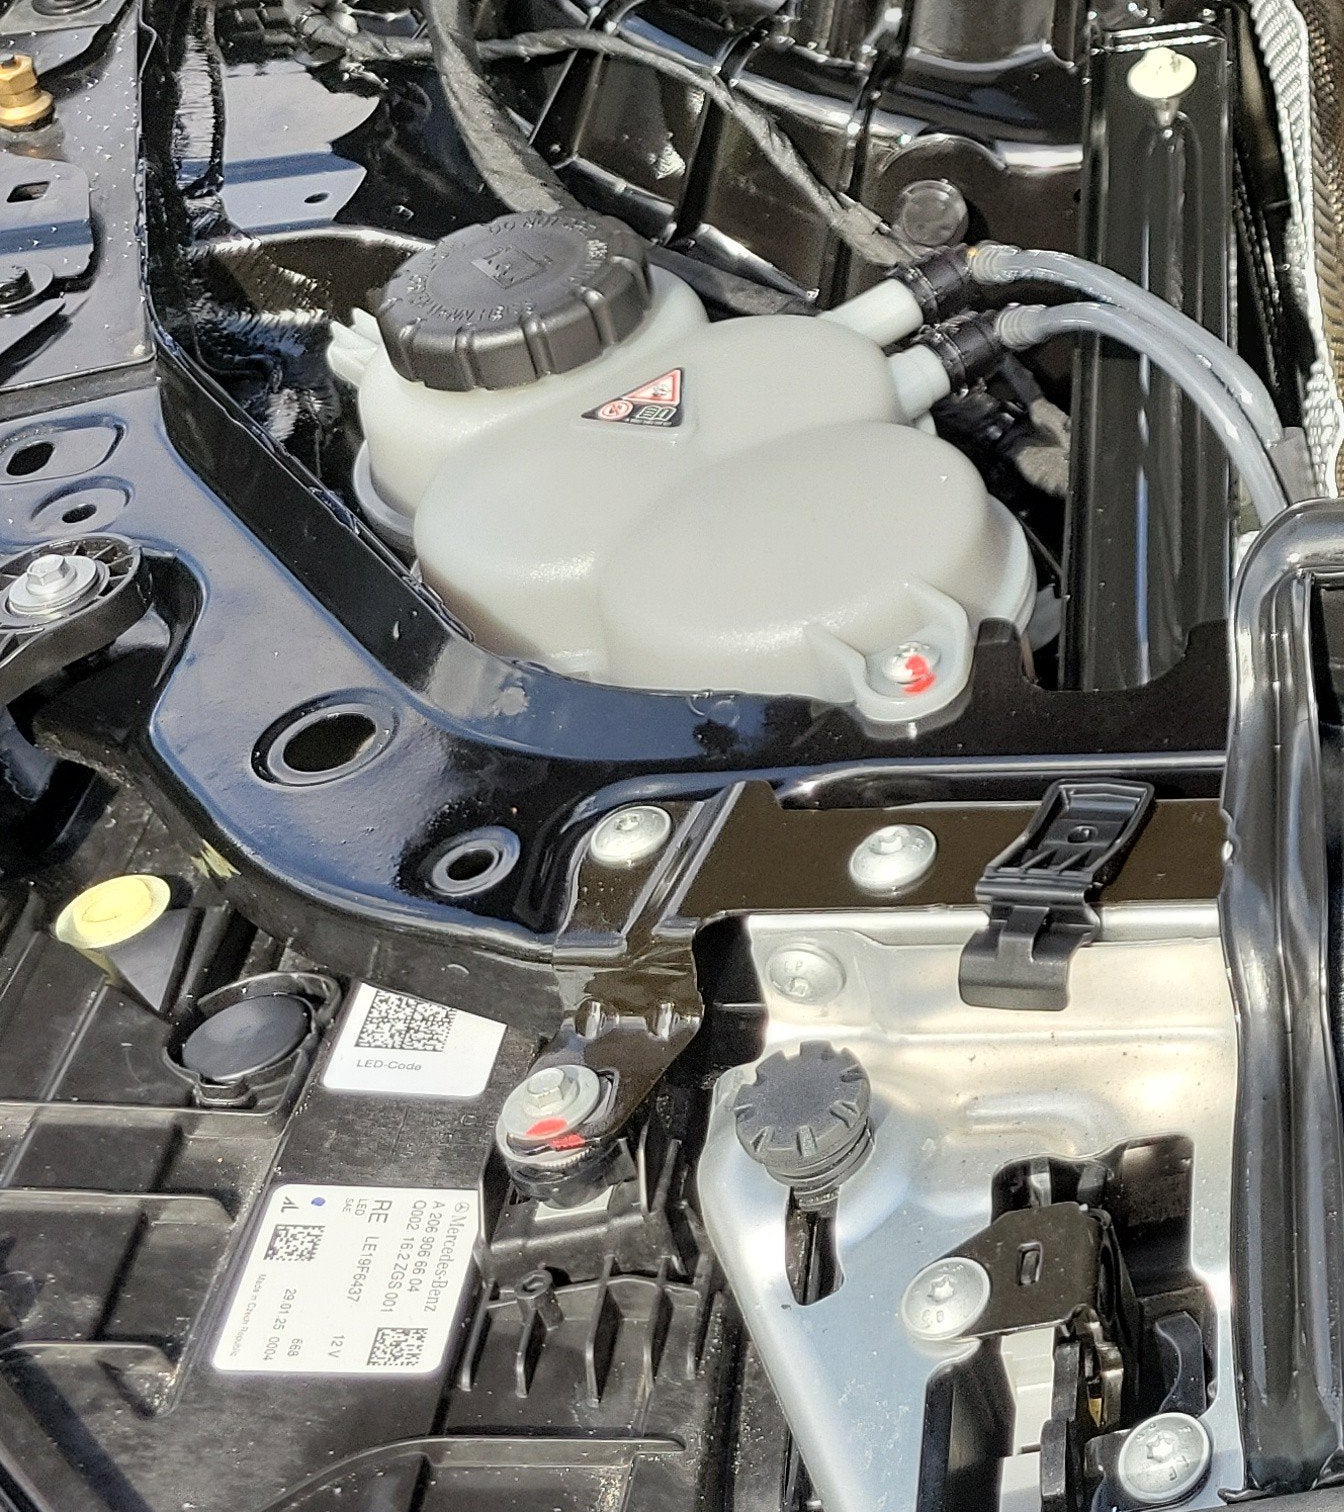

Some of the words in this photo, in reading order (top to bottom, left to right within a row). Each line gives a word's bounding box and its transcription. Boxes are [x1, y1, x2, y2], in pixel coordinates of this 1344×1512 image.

[356, 1059, 422, 1071] LED-Code
[354, 1198, 369, 1216] LED
[367, 1199, 393, 1223] RE
[406, 1199, 427, 1231] Q002
[432, 1200, 446, 1210] A
[425, 1212, 443, 1234] 206
[417, 1236, 435, 1258] 906
[346, 1236, 380, 1303] LE19F6437
[412, 1260, 428, 1275] 66
[424, 1215, 467, 1312] Mercedes-Benz
[407, 1277, 423, 1292] 04
[272, 1288, 297, 1330] 29.01.25
[380, 1291, 399, 1312] 001
[263, 1336, 280, 1361] 0004
[330, 1334, 346, 1347] 12
[327, 1349, 342, 1358] V
